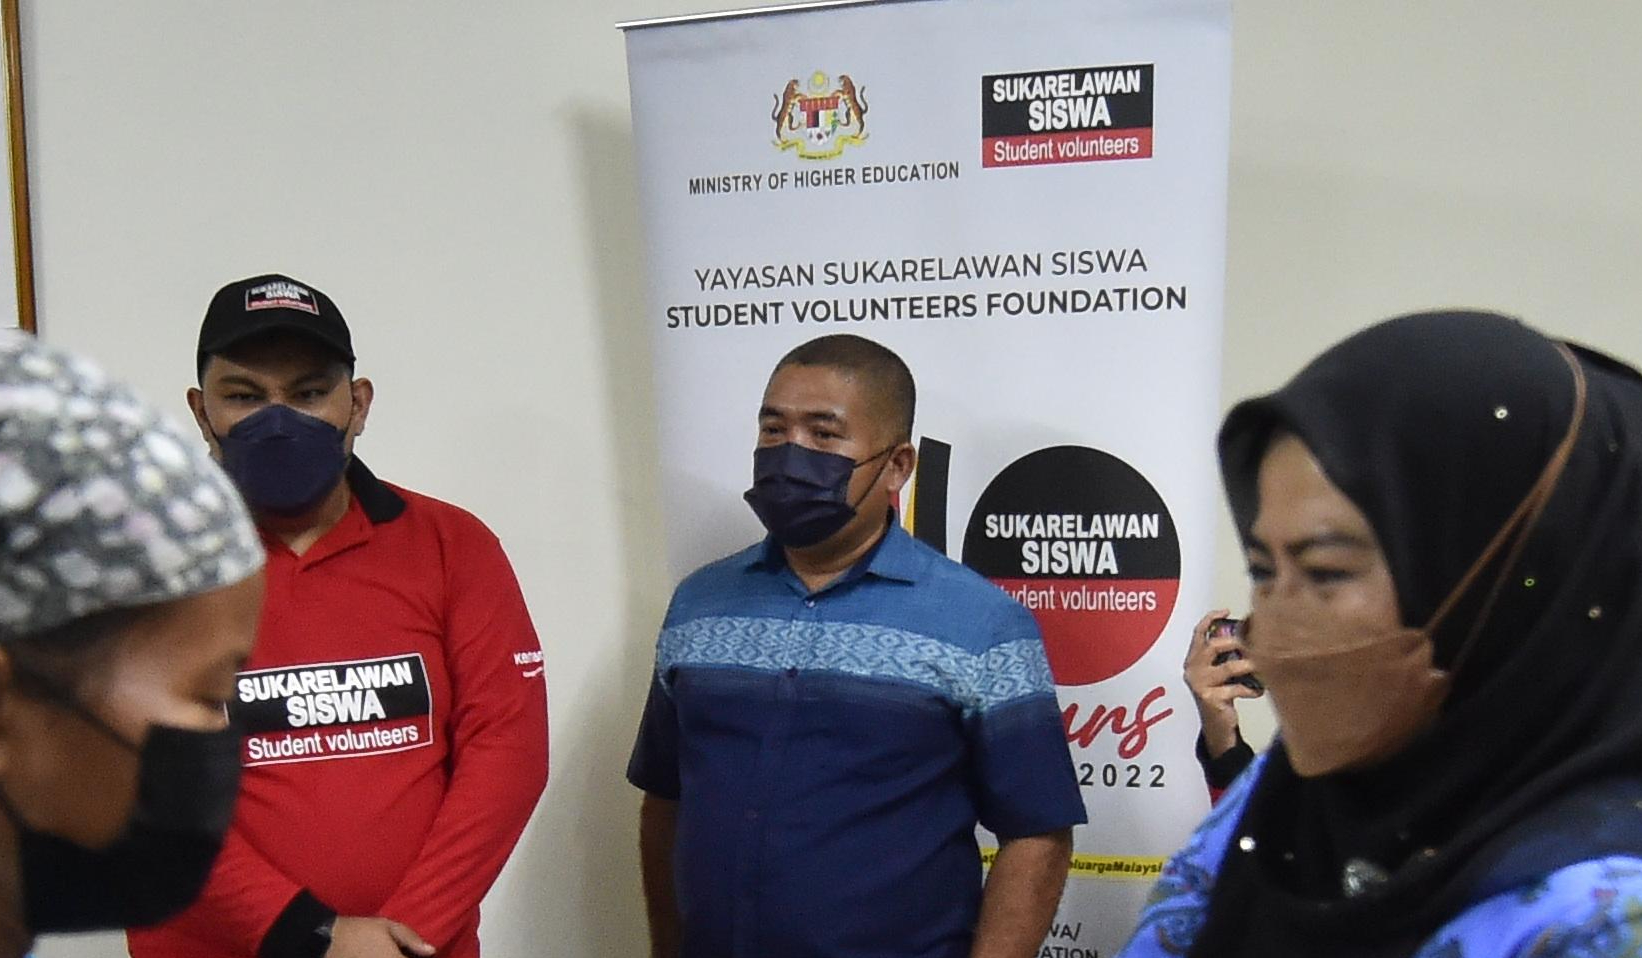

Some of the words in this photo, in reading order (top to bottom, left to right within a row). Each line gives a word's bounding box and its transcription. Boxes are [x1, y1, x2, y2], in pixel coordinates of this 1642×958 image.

[992, 69, 1141, 102] SUKARELAWAN
[1028, 96, 1112, 131] SISWA
[994, 138, 1054, 162] Student
[1057, 136, 1139, 157] volunteers
[689, 174, 763, 196] MINISTRY
[768, 172, 789, 190] OF
[794, 168, 856, 189] HIGHER
[862, 161, 959, 184] EDUCATION
[694, 263, 814, 291] YAYASAN
[823, 253, 1042, 286] SUKARELAWAN
[1051, 249, 1148, 275] SISWA
[667, 302, 784, 328] STUDENT
[791, 293, 977, 323] VOLUNTEERS
[986, 286, 1187, 316] FOUNDATION
[985, 514, 1159, 539] SUKARELAWAN
[1021, 541, 1119, 575] SISWA
[1060, 586, 1157, 610] volunteers
[238, 661, 413, 703] SUKARELAWAN
[286, 689, 386, 727] SISWA
[248, 732, 323, 760] Student
[326, 725, 419, 752] volunteers
